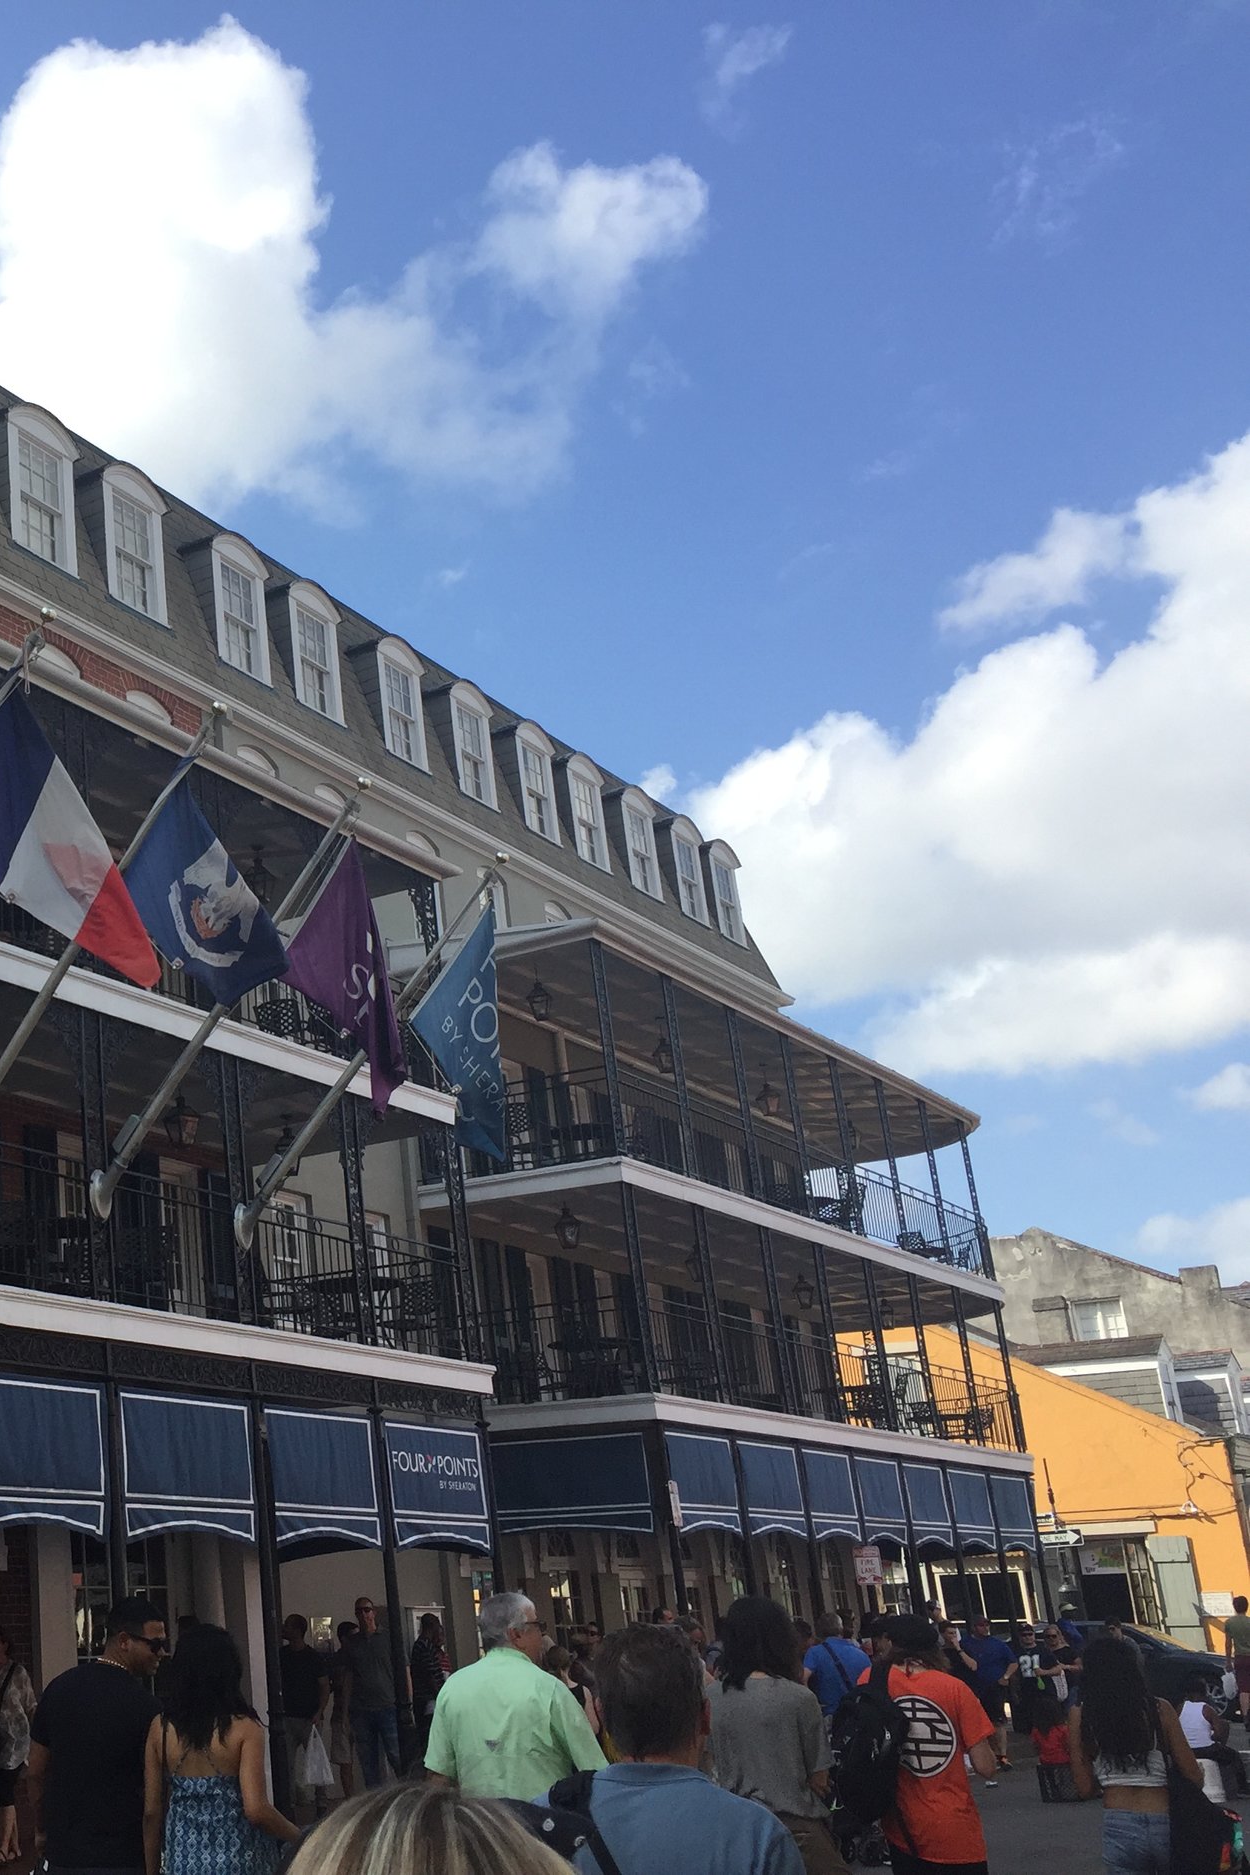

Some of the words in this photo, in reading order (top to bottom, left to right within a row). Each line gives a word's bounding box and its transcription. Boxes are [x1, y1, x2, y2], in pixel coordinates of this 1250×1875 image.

[441, 1015, 463, 1044] BY
[391, 1450, 428, 1474] FOUR
[437, 1455, 478, 1478] POINTS
[439, 1480, 447, 1489] BY
[448, 1481, 477, 1491] SHERATON
[1019, 1654, 1040, 1678] 21
